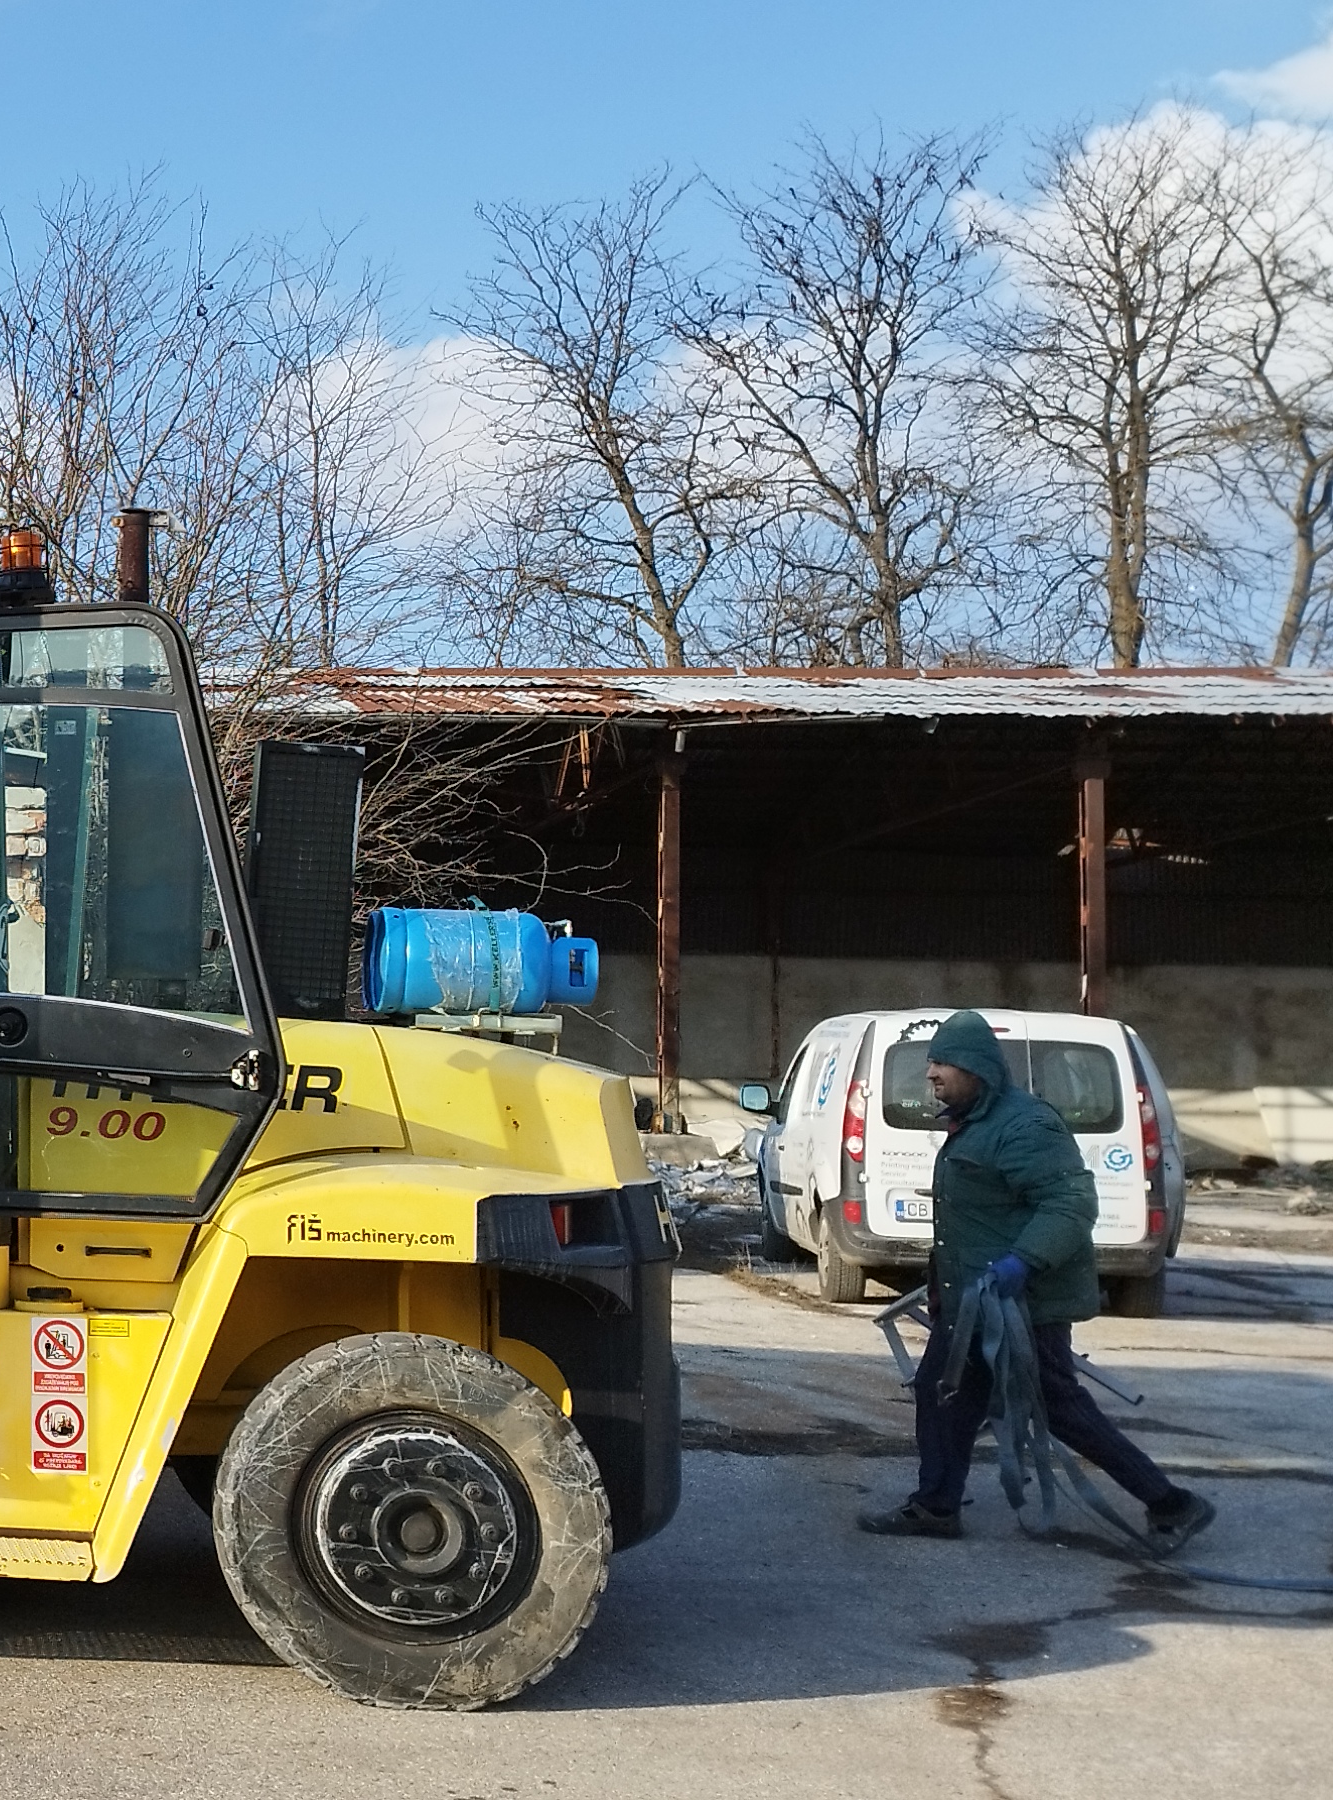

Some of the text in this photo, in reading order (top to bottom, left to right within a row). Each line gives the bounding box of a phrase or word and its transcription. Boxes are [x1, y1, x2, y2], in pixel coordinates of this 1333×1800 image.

[46, 1105, 166, 1141] 9.00
[907, 1202, 928, 1217] CB
[326, 1228, 455, 1248] machinery.com
